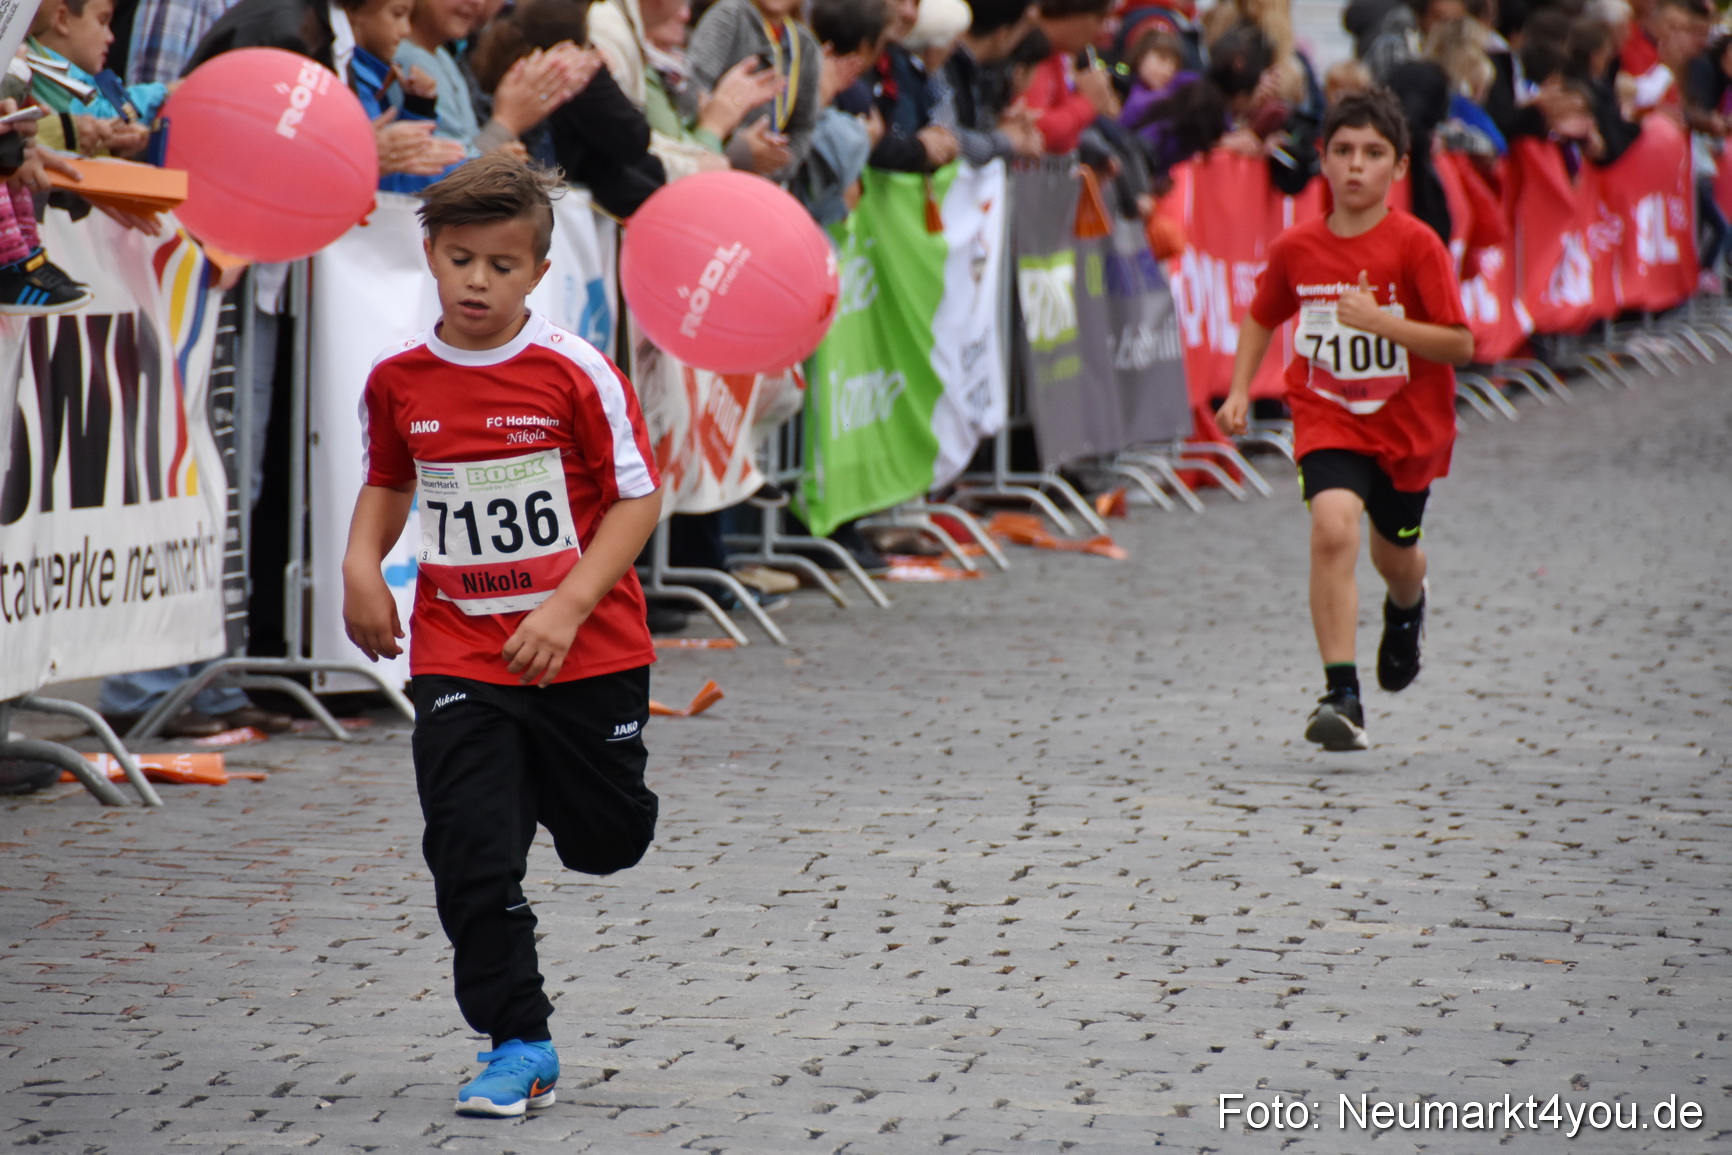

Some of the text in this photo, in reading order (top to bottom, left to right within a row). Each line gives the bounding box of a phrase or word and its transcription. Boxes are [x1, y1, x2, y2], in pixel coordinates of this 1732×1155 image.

[1305, 334, 1397, 373] 7100
[410, 420, 440, 434] JAKO
[486, 415, 560, 428] FC Holzheim
[506, 428, 546, 445] Nikola
[466, 457, 548, 485] BOCK
[426, 490, 560, 556] 7136
[461, 569, 533, 594] Nikola
[431, 692, 467, 712] Nikola
[613, 720, 639, 736] JAKO
